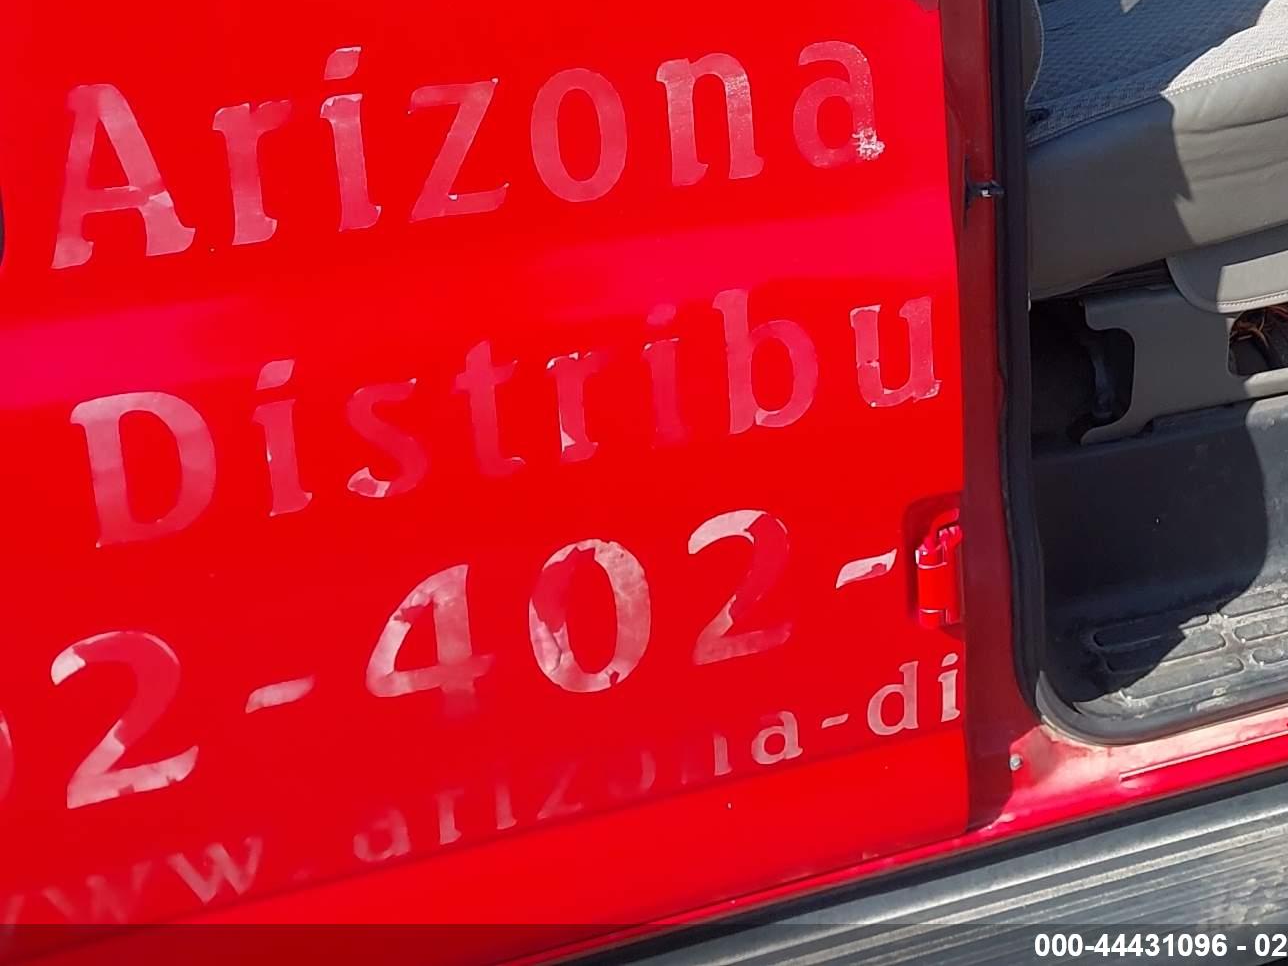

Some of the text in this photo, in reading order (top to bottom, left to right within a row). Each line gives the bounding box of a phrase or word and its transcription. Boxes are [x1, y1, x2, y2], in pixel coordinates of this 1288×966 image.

[51, 39, 885, 270] Arizona
[70, 288, 942, 548] Distribu
[0, 507, 898, 810] 2-402-
